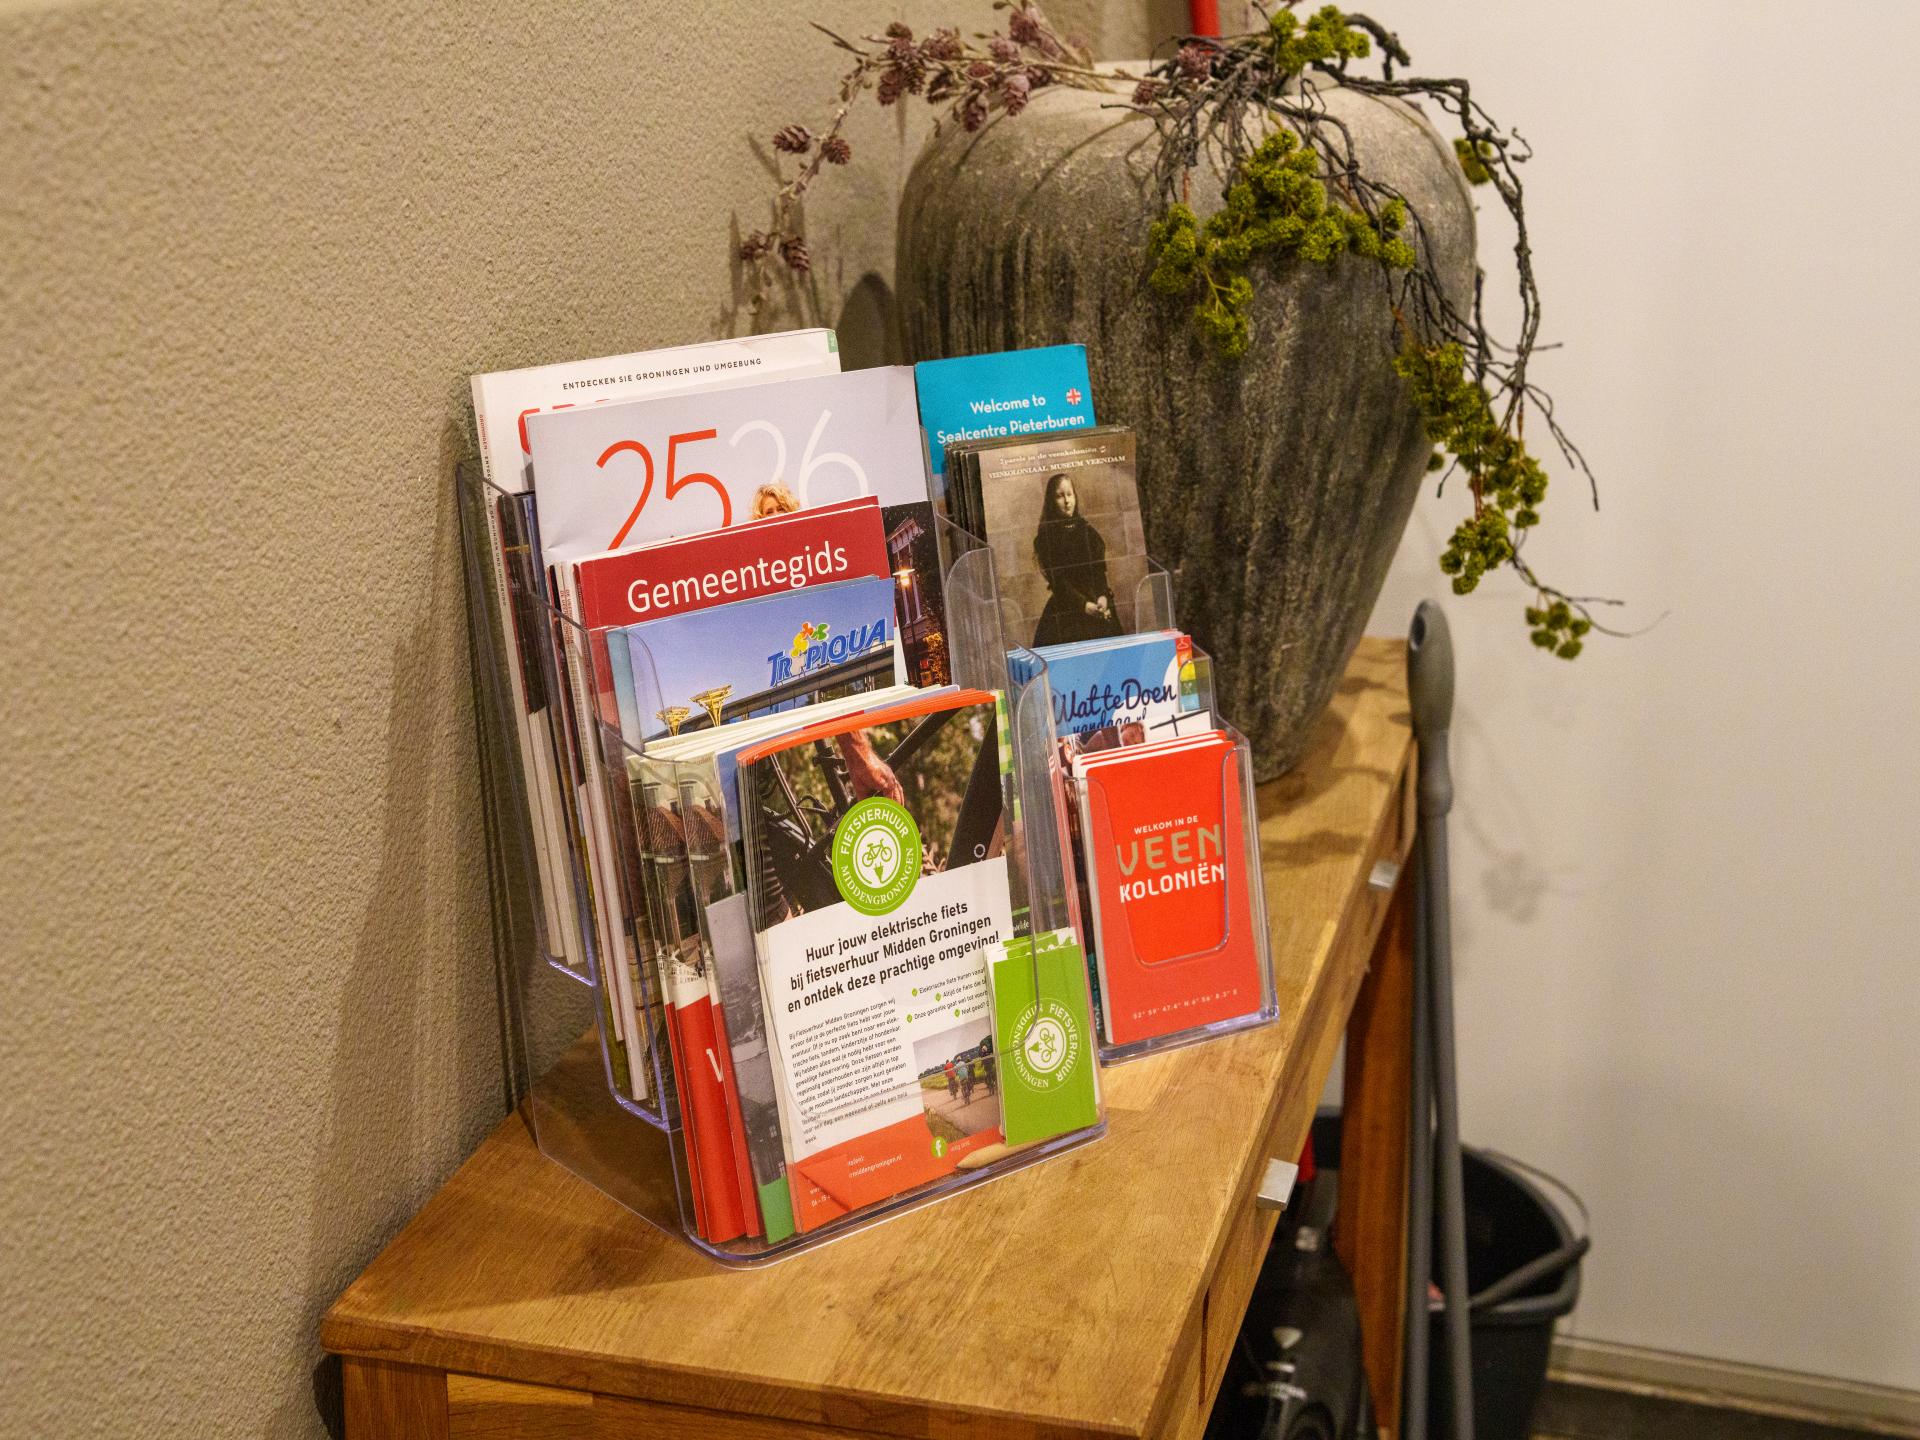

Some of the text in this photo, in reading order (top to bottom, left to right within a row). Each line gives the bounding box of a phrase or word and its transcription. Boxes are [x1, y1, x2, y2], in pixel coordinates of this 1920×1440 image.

[563, 358, 762, 390] ENTDECKEN SIE GRONINGEN UND UMGEBUNG
[937, 415, 1084, 444] Sealcentre Pieterburen
[970, 394, 1045, 414] Welcome to
[989, 455, 1125, 479] VEENKOLONIAAL MUSEUM VEENDAM
[627, 541, 848, 613] Gemeentegids
[767, 617, 887, 687] TRPIQUA
[841, 808, 909, 855] FIETSVERHUUR
[1117, 824, 1222, 876] VEEN
[1134, 821, 1172, 834] WELKOM
[1175, 818, 1184, 826] IN
[841, 847, 914, 905] MIDDENGRONINGEN
[1119, 862, 1225, 903] KOLONIËN
[790, 974, 804, 991] bij
[806, 950, 879, 985] fietsverhuur
[883, 937, 926, 959] Midden
[929, 916, 991, 943] Groningen
[806, 902, 968, 962] Huur jouw elektrische fiets
[788, 931, 999, 1012] en ontdek deze prachtige omgeving!
[1050, 1003, 1077, 1081] FIETSVERHUUR
